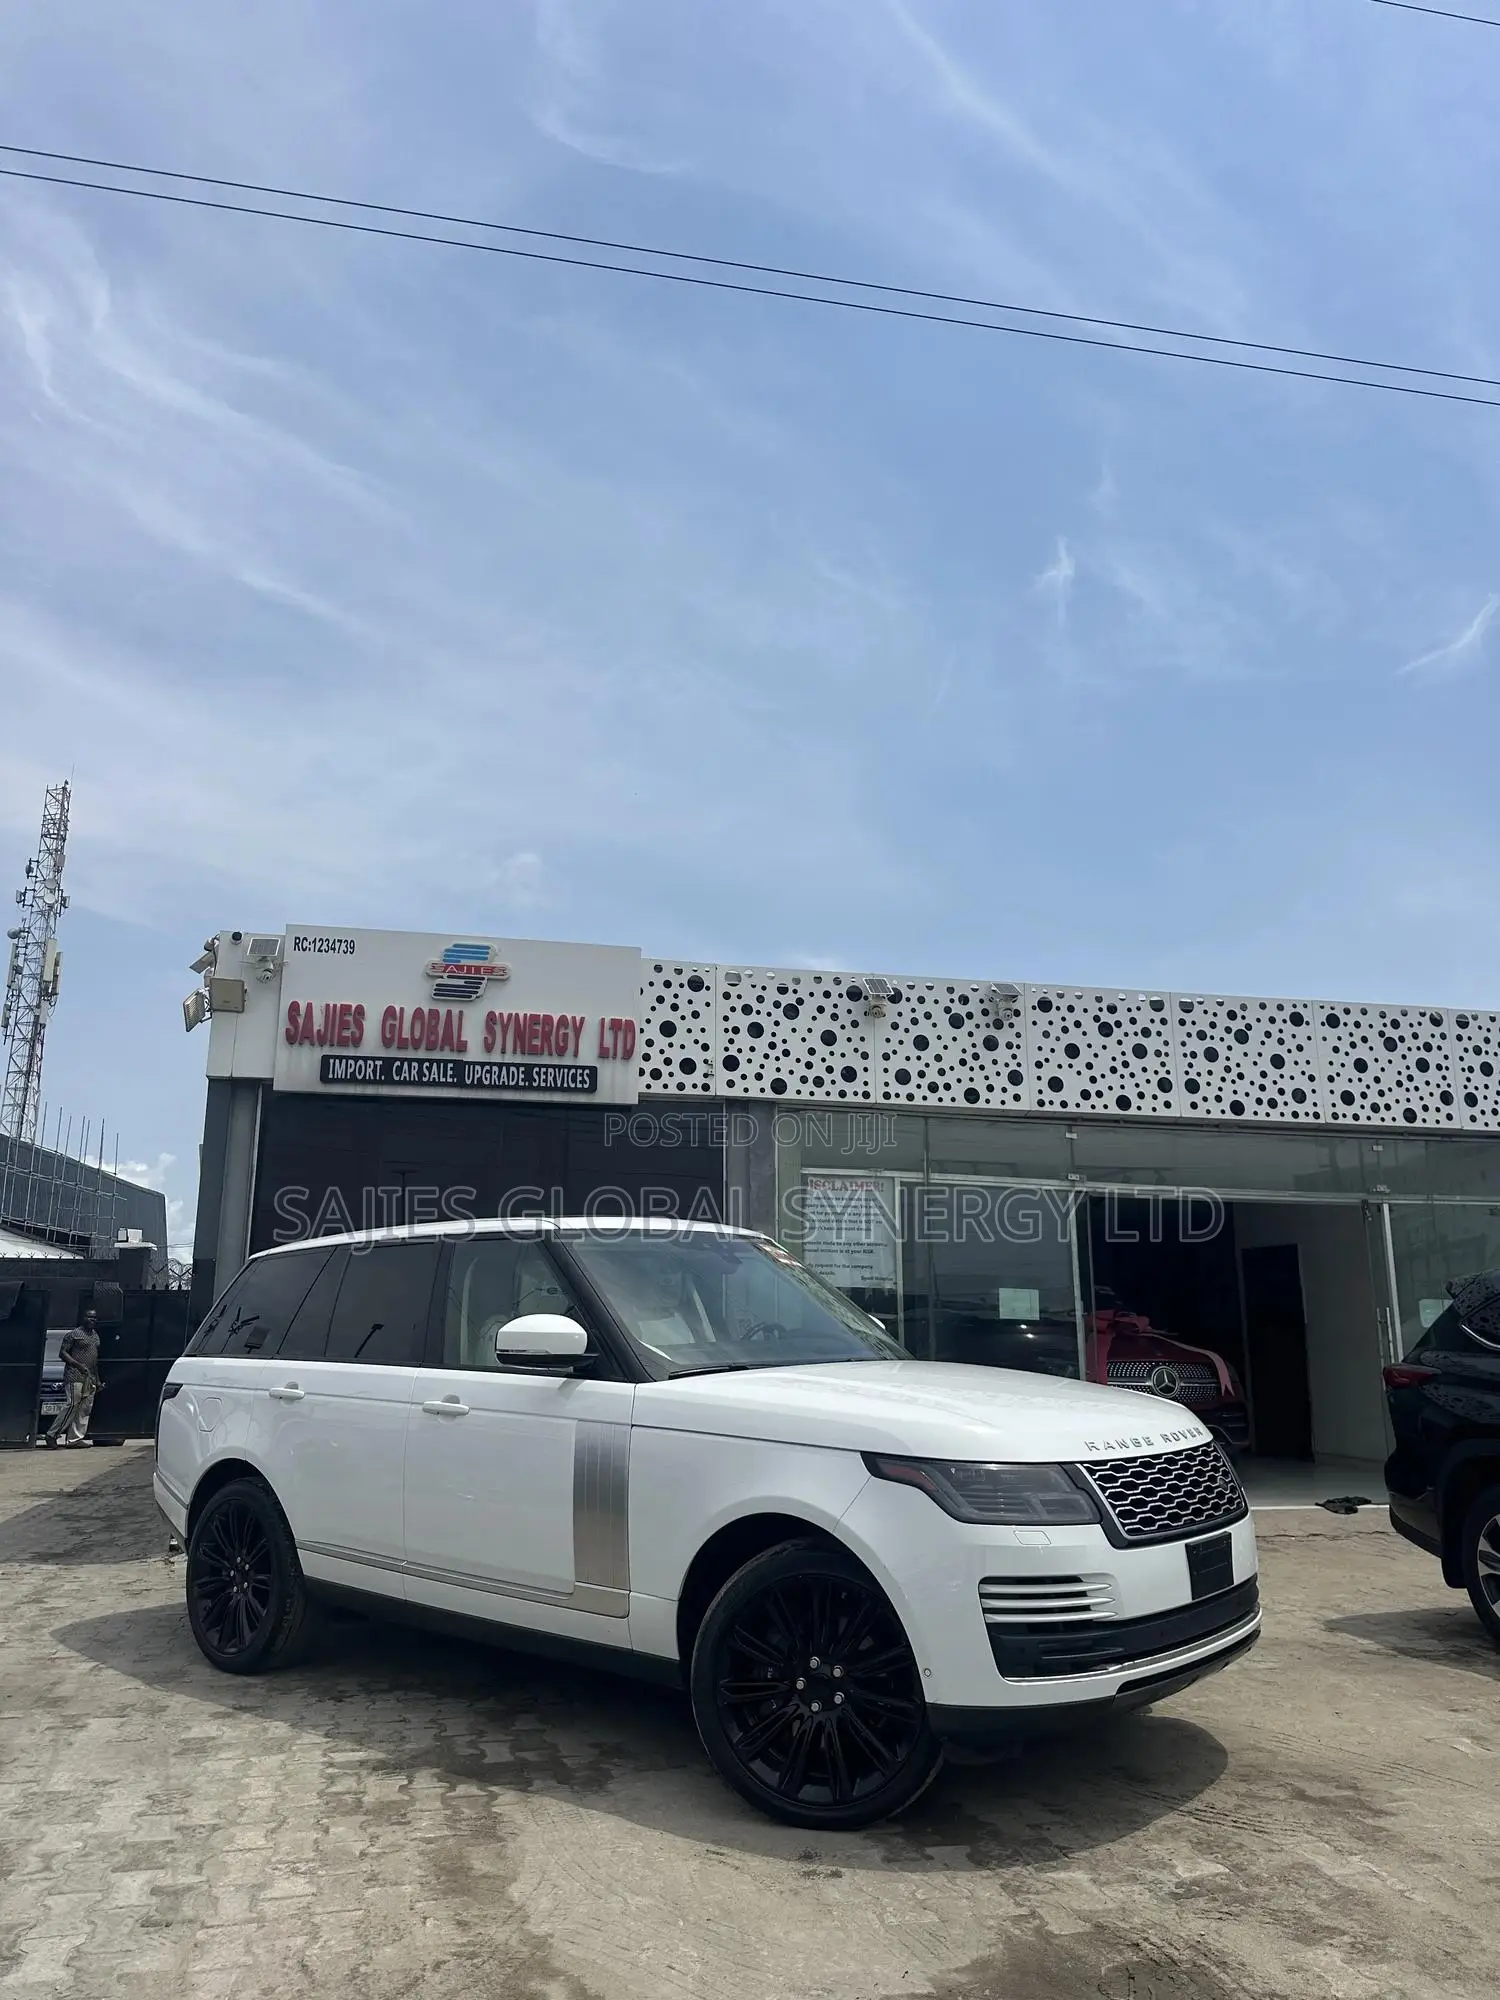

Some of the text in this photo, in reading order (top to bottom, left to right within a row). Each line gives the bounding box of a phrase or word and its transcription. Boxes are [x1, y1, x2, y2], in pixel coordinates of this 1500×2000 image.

[293, 936, 355, 955] RC:1234739
[430, 962, 508, 977] SAJIES
[285, 1000, 637, 1060] SAJIES GLOBAL SYNERGY LTD
[328, 1058, 590, 1089] IMPORT. CAR SALE. UPGRADE. SERVICES
[807, 1179, 884, 1192] ISCLAIMER!
[1085, 1427, 1204, 1452] RANGE ROVER
